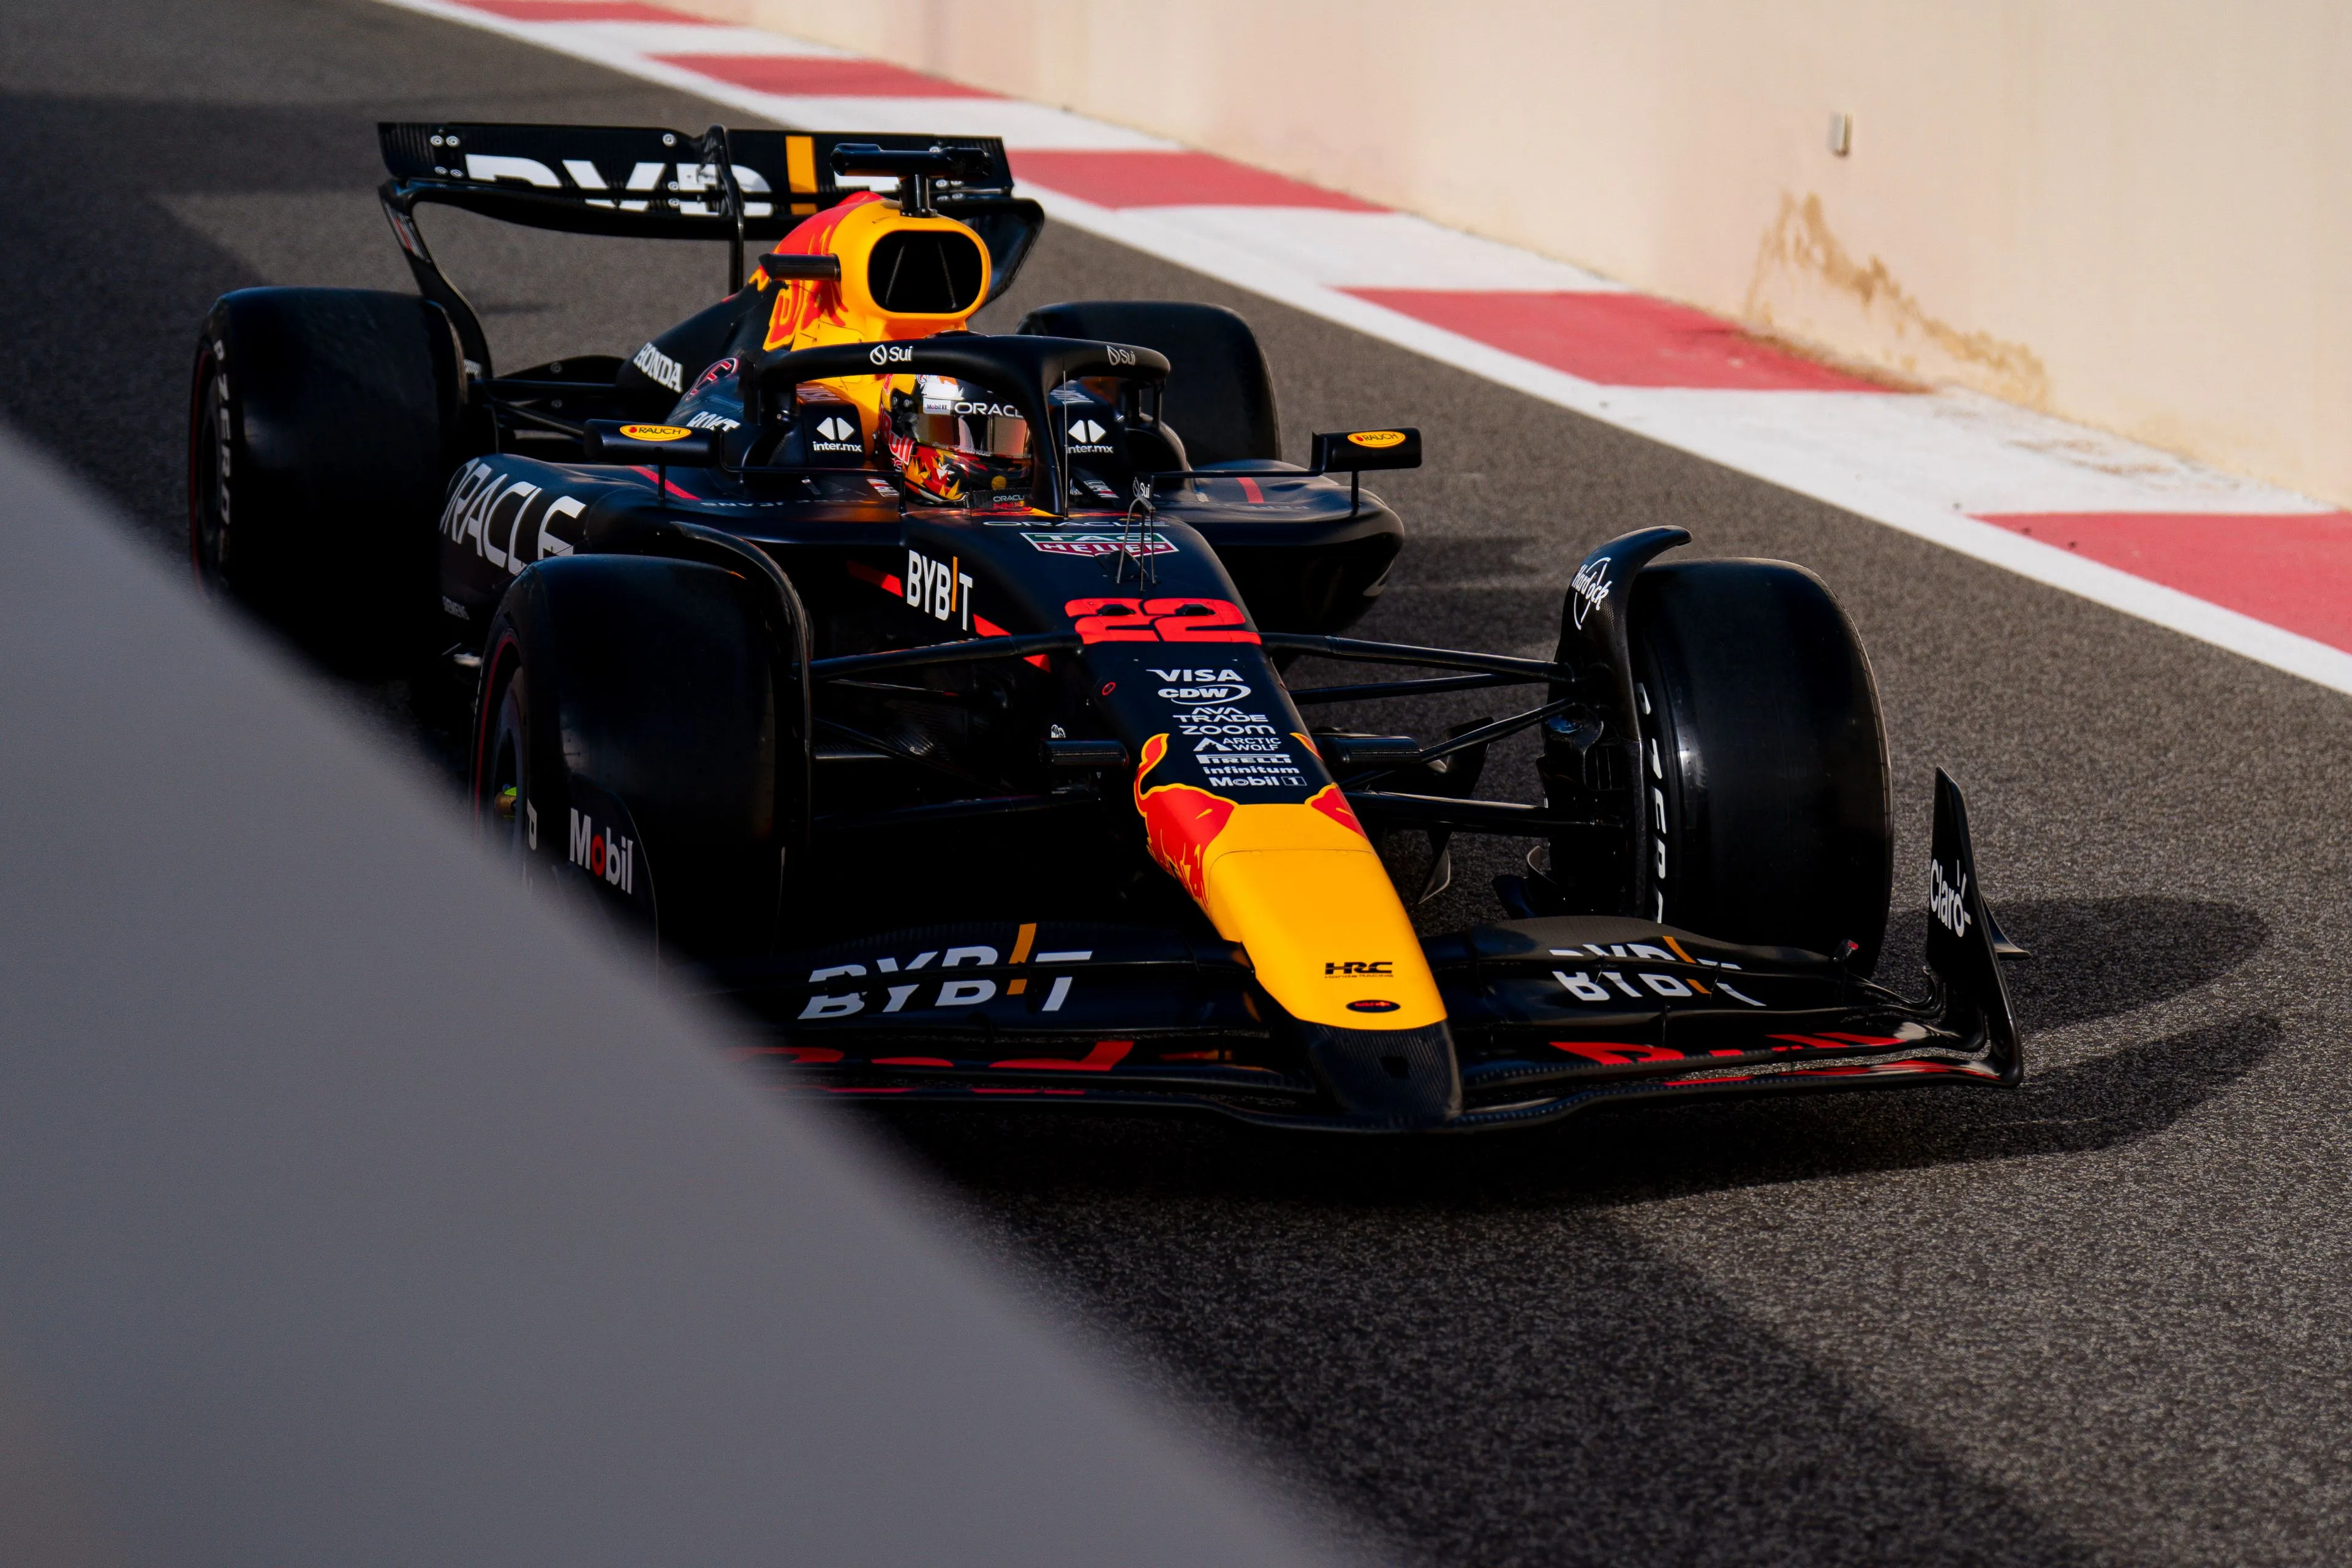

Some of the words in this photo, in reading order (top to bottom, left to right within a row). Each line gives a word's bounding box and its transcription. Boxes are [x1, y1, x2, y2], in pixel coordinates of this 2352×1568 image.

[889, 345, 913, 363] Sui
[1121, 348, 1136, 366] Sui
[633, 342, 684, 394] HONDA
[954, 401, 1024, 419] ORACL
[1362, 432, 1400, 441] RAUCH
[812, 440, 863, 453] inter.mx
[1139, 481, 1150, 499] Sui
[1042, 543, 1169, 554] HEUER
[907, 550, 973, 631] BYBIT
[1065, 598, 1262, 645] 22
[1146, 669, 1244, 682] VISA
[1158, 688, 1229, 698] CDW
[1173, 714, 1268, 723] TRADE
[1196, 754, 1292, 764] PIRELLI
[1209, 776, 1280, 786] Mobil
[570, 808, 633, 894] Mobil
[1929, 859, 1966, 937] Claro
[1324, 962, 1393, 975] HRC
